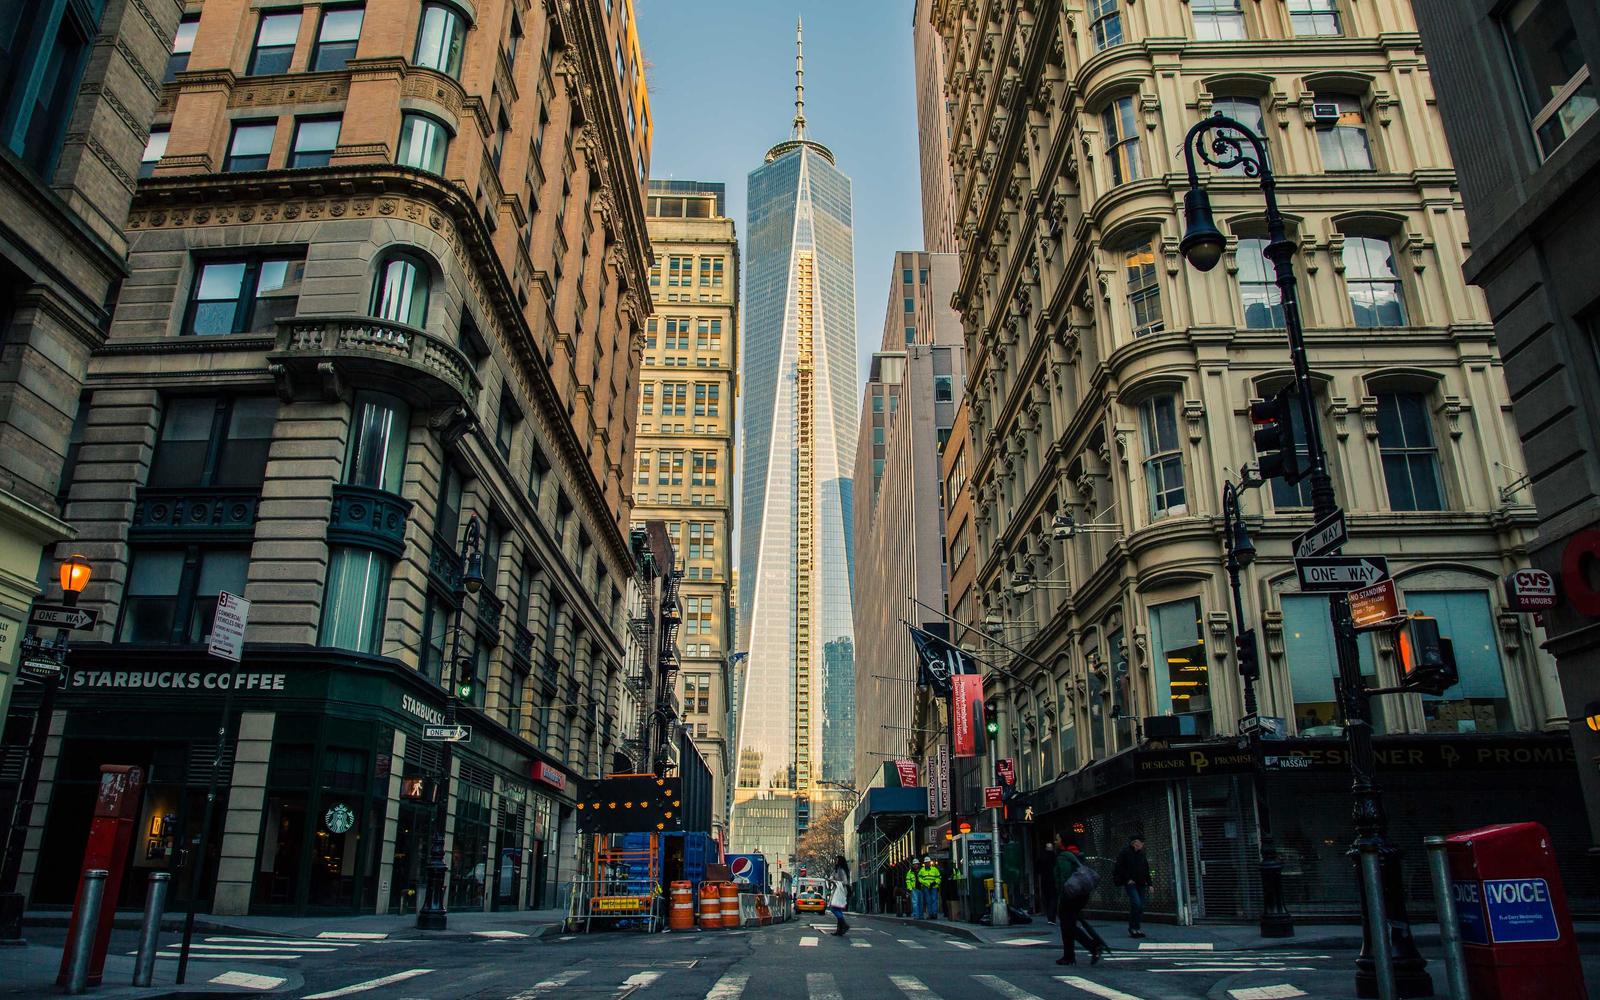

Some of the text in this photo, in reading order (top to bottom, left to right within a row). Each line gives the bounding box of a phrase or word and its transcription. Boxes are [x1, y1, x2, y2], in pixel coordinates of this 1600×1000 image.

[1300, 523, 1338, 557] ONE WAY
[1311, 567, 1374, 581] ONE WAY
[1516, 573, 1550, 586] CVS
[221, 593, 227, 606] 3
[1351, 585, 1387, 601] NO STANDING
[1531, 597, 1552, 605] HOURS
[39, 611, 87, 624] ONE WAY
[73, 670, 286, 690] STARBUCKS COFFEE
[402, 694, 442, 725] STARBUCKS
[1142, 759, 1184, 769] DESIGNER
[1280, 758, 1308, 768] NASSAU
[1453, 884, 1479, 903] OICE
[1491, 882, 1547, 904] VOICE
